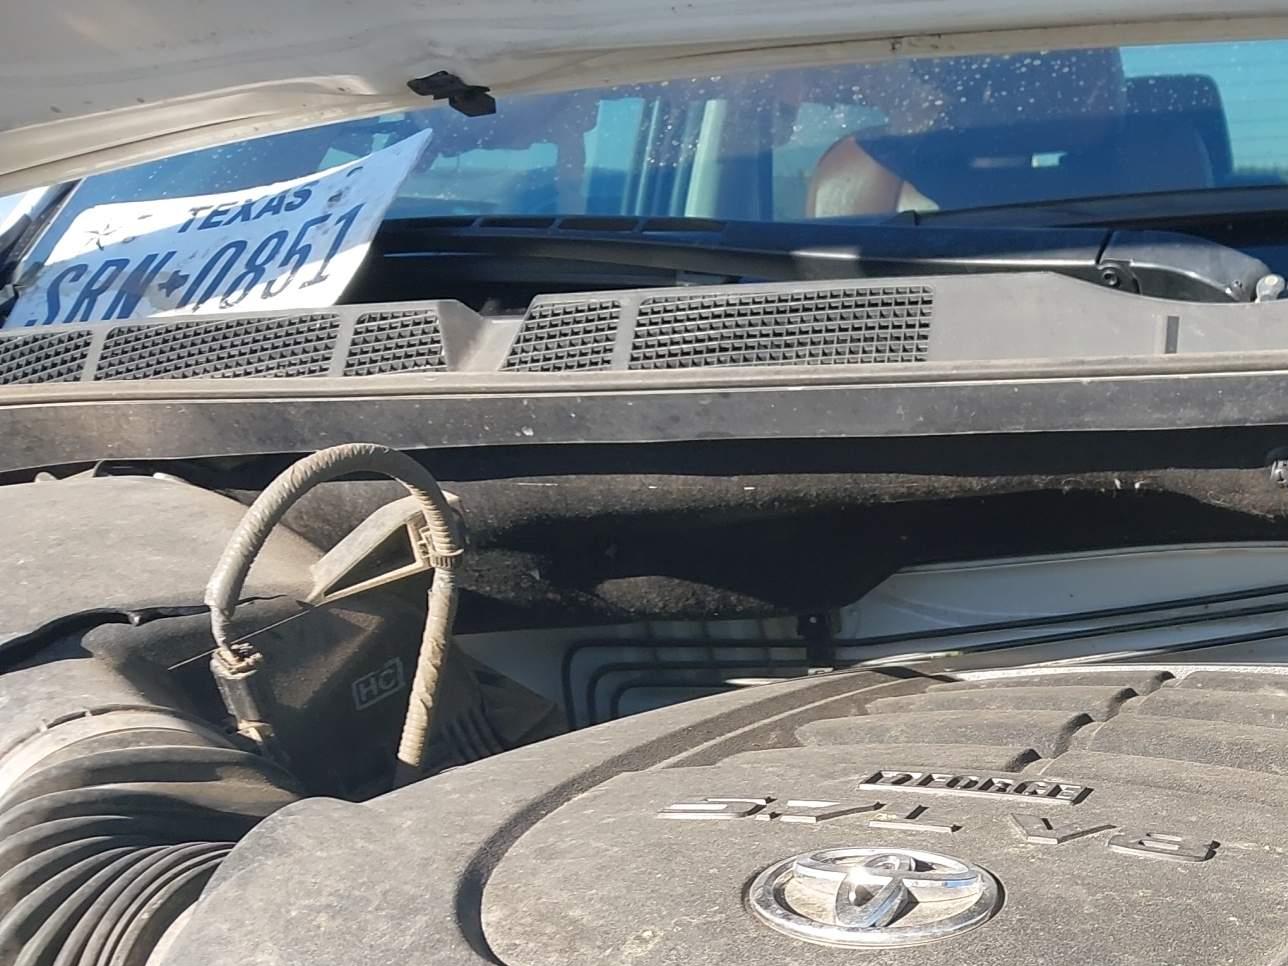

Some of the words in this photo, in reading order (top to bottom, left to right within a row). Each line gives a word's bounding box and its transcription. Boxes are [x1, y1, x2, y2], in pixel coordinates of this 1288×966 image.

[177, 180, 319, 233] TEXAS
[176, 202, 365, 313] 0851
[359, 669, 397, 702] HC
[1006, 811, 1222, 863] V8
